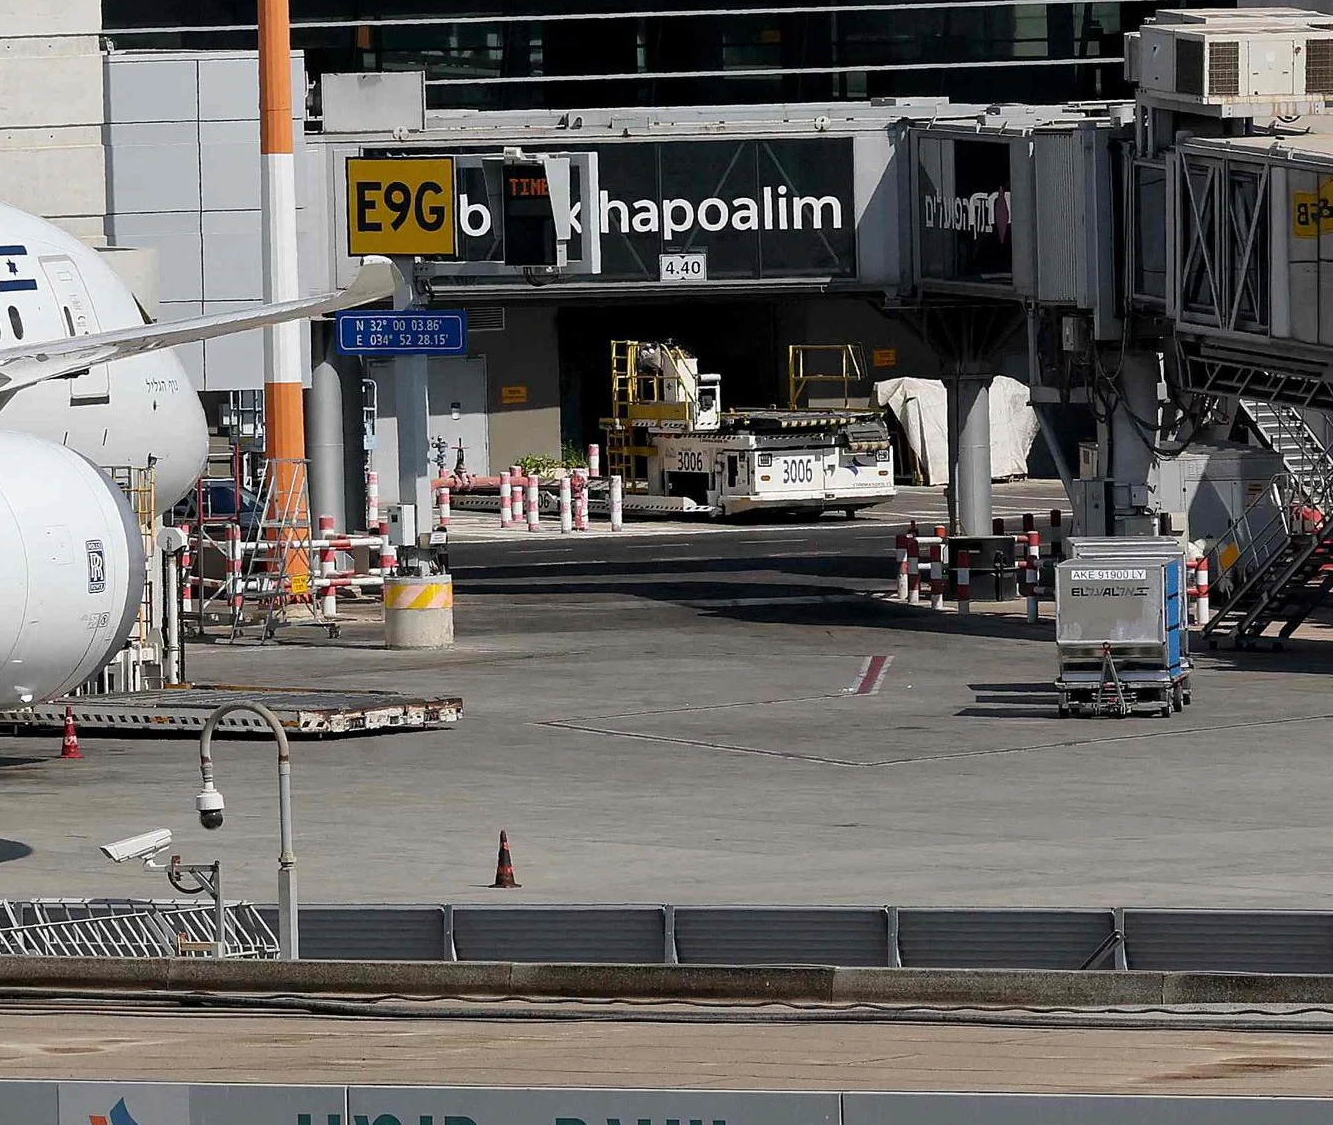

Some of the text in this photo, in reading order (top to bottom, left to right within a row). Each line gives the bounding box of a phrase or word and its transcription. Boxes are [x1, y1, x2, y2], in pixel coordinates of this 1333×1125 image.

[356, 180, 446, 232] E9G
[600, 185, 843, 240] hapoalim
[665, 260, 701, 276] 4.40
[356, 320, 364, 331] N
[370, 319, 387, 331] 32°
[393, 320, 406, 331] 00
[356, 334, 363, 346] E
[370, 334, 393, 346] 034°
[399, 334, 412, 346] 52
[677, 451, 703, 471] 3006
[783, 458, 813, 483] 3006
[1073, 570, 1144, 579] AKE 91900 LY
